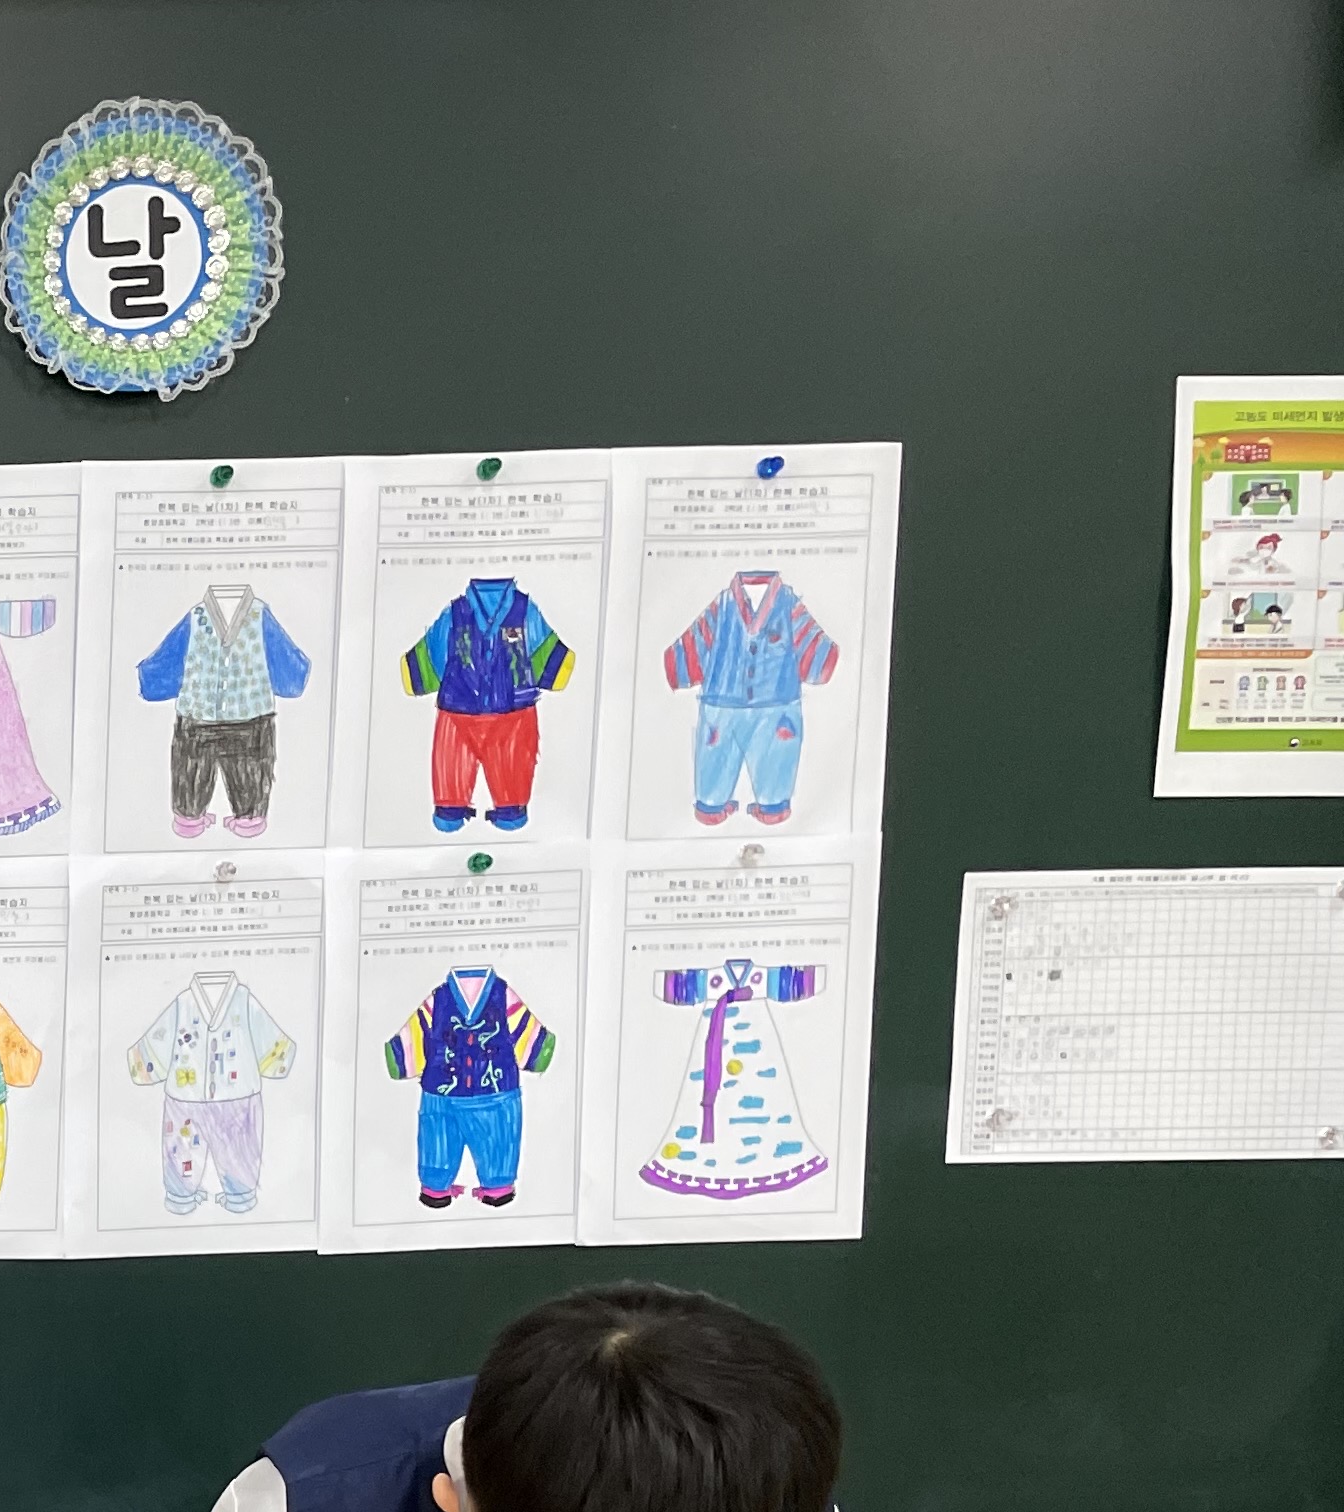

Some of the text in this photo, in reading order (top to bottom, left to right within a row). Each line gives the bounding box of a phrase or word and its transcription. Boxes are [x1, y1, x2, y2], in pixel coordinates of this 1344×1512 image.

[86, 195, 182, 321] 날
[1235, 411, 1267, 422] 고농도
[1273, 411, 1318, 422] 미세먼지
